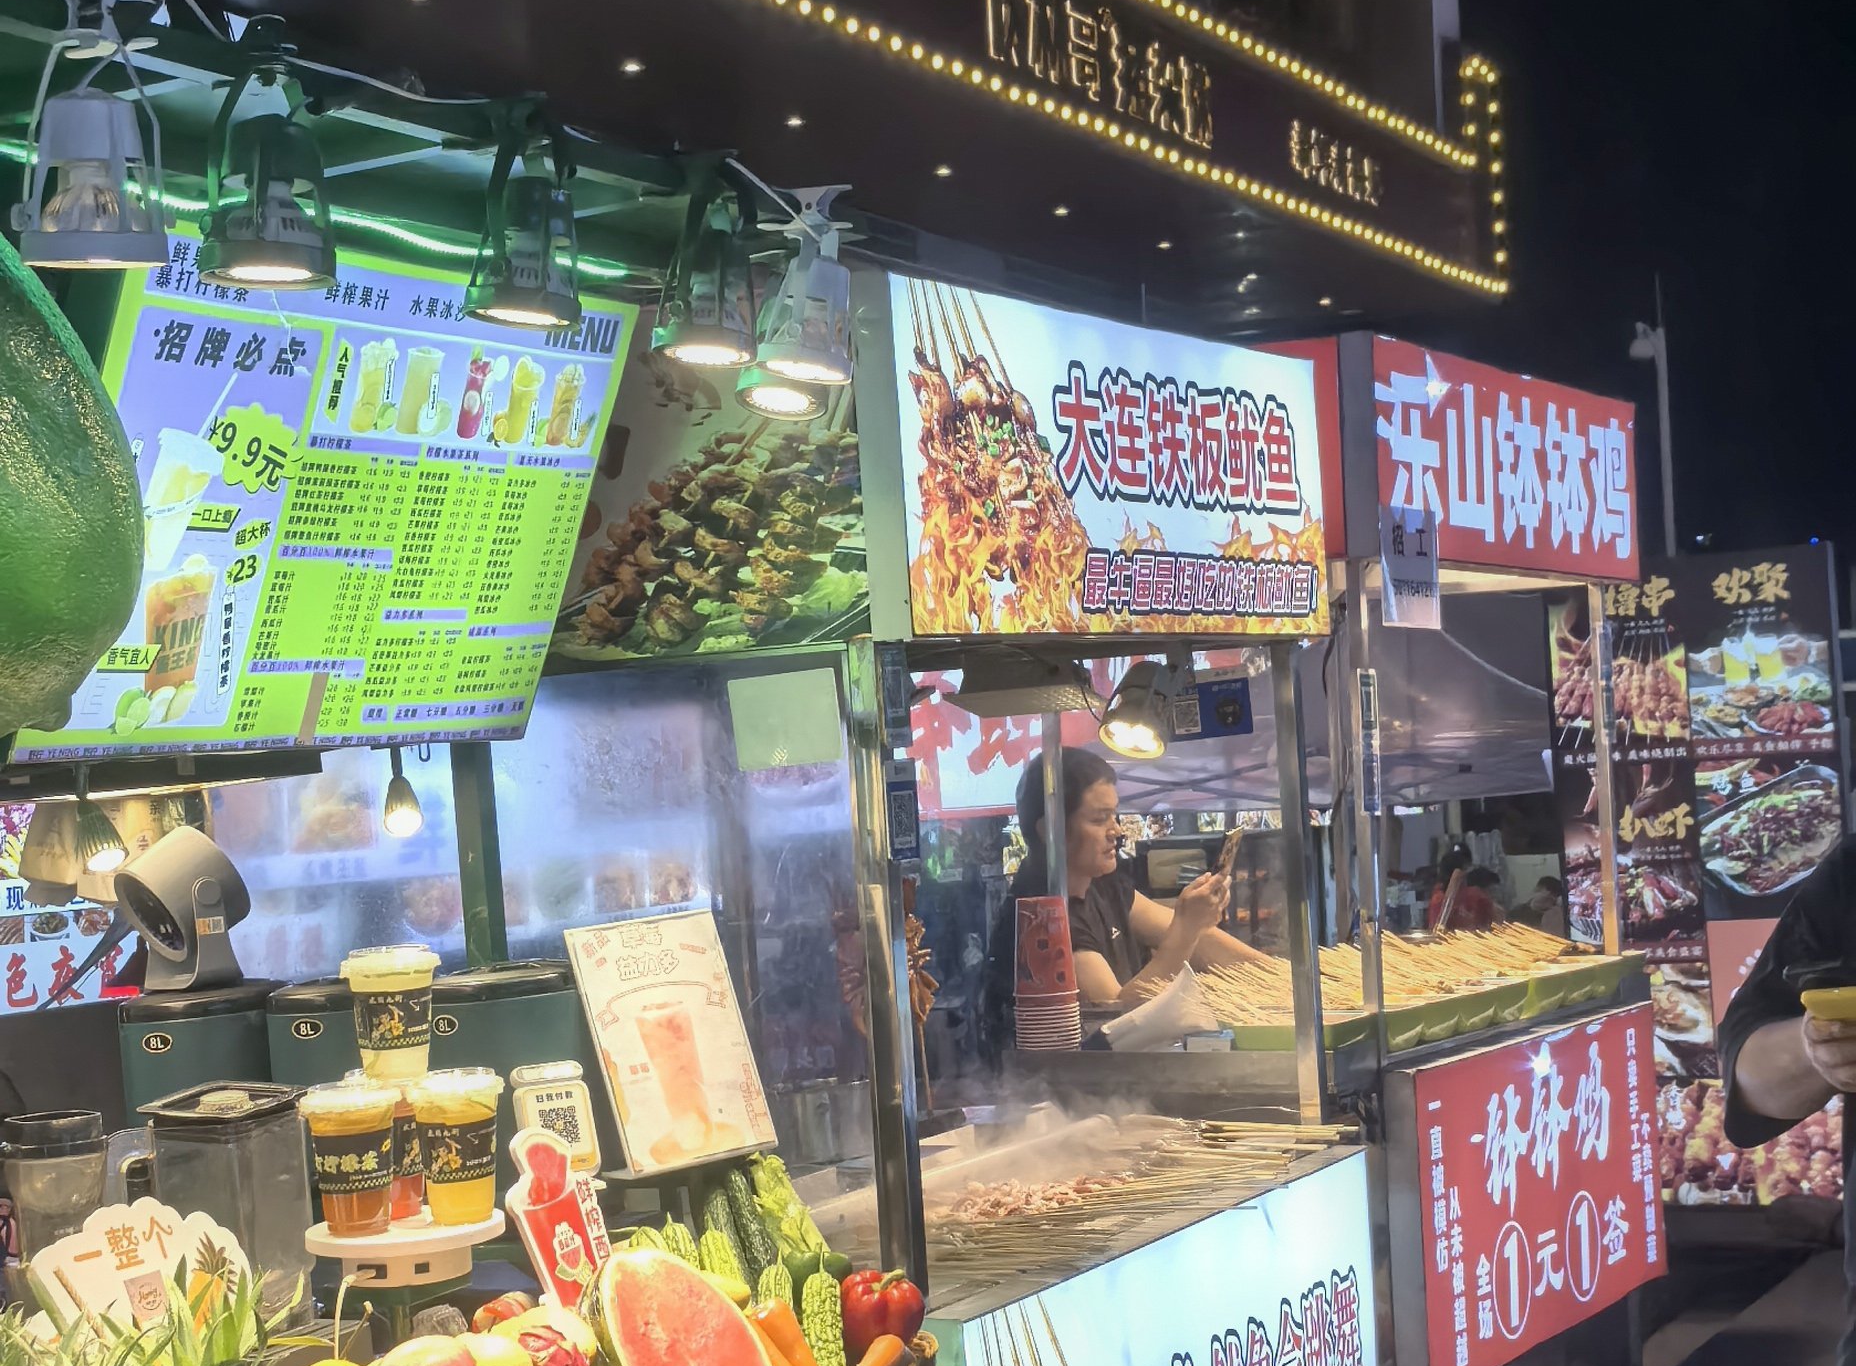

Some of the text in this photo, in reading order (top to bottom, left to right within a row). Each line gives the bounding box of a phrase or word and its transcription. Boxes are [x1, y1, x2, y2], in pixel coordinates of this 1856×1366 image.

[324, 280, 390, 311] 鲜榨果汁
[208, 415, 288, 486] ¥9.9元
[1053, 362, 1303, 513] 大连铁板鱿鱼
[1374, 370, 1632, 559] 乐山钵钵鸡
[235, 521, 271, 546] 超大杯
[1712, 562, 1792, 605] 欢聚
[107, 648, 151, 666] 香气宜人
[299, 1022, 315, 1035] 8L
[438, 1019, 453, 1032] 8L
[149, 1036, 165, 1049] 8L
[74, 1216, 173, 1271] 一整个
